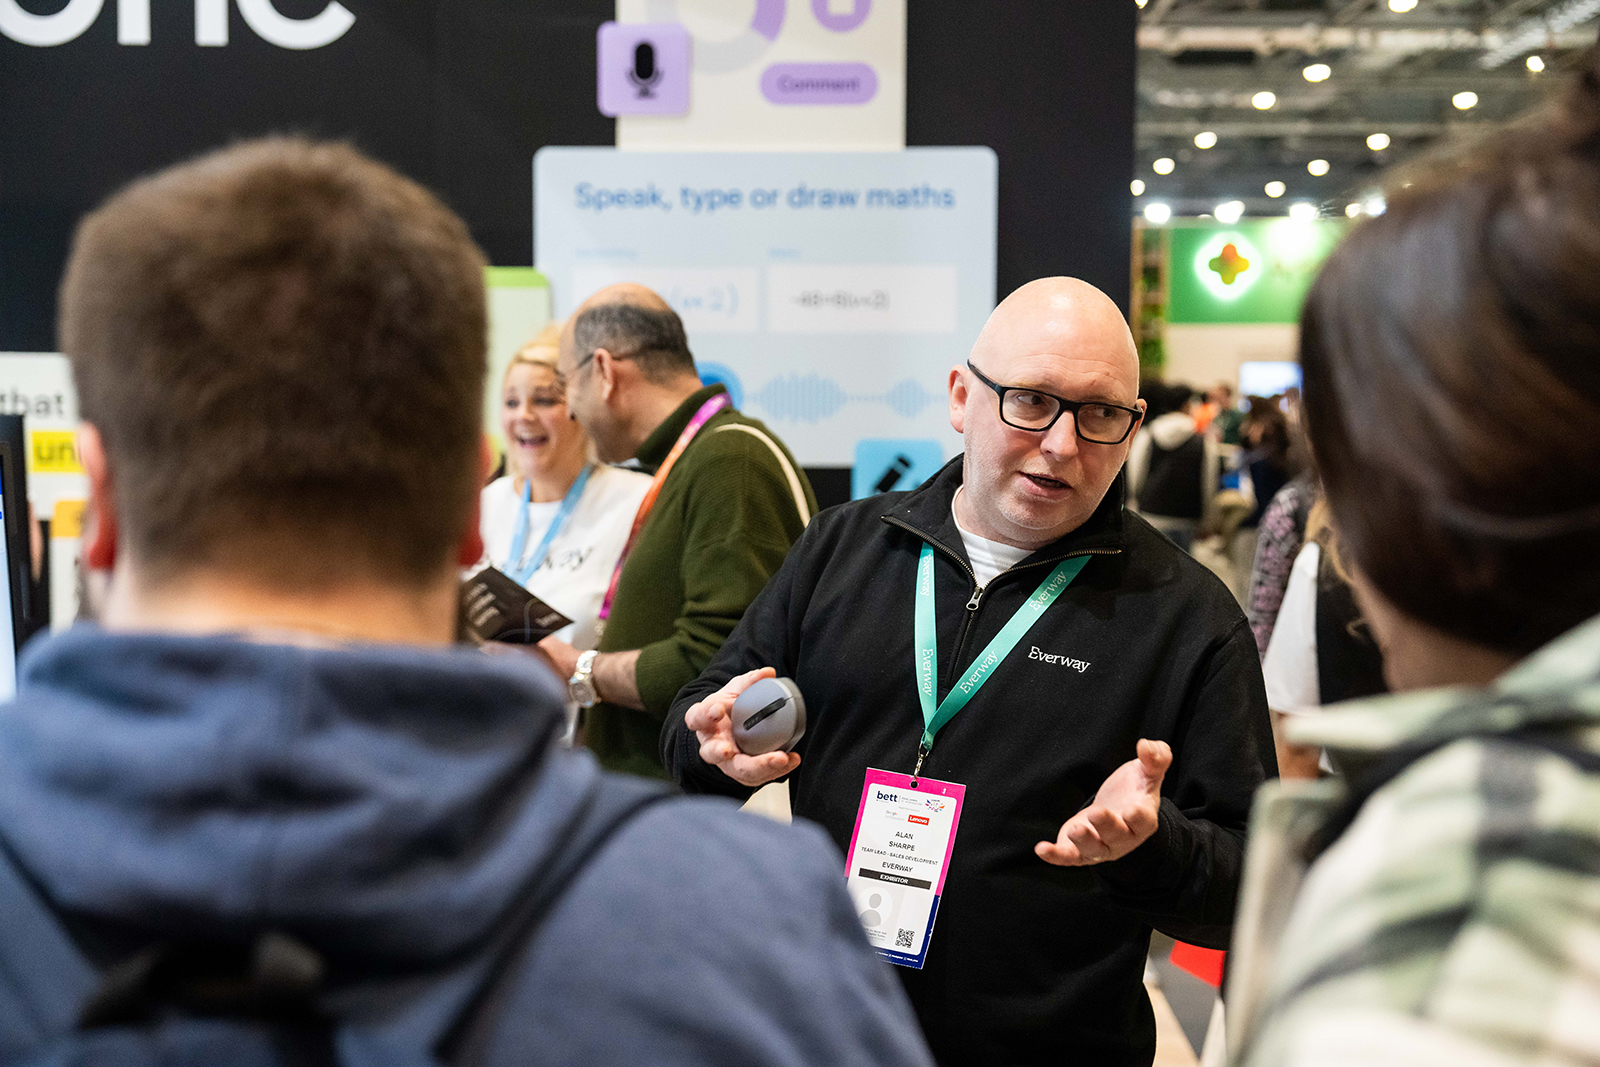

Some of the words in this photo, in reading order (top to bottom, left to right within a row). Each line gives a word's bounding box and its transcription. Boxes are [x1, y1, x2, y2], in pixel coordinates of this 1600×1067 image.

[574, 181, 672, 212] Speak,
[680, 184, 743, 215] type
[749, 188, 780, 209] or
[786, 182, 861, 210] draw
[865, 182, 956, 209] maths
[920, 554, 931, 596] Everway
[1029, 570, 1067, 611] Everway
[1028, 646, 1091, 673] Everway
[922, 649, 934, 696] Everway
[959, 650, 998, 694] Everway
[877, 790, 898, 803] bett
[895, 831, 913, 840] ALAN
[889, 841, 915, 851] SHARPE
[882, 862, 913, 872] EVERWAY
[905, 857, 938, 865] DEVELOPMENT
[880, 874, 908, 884] EXHIBITOR
